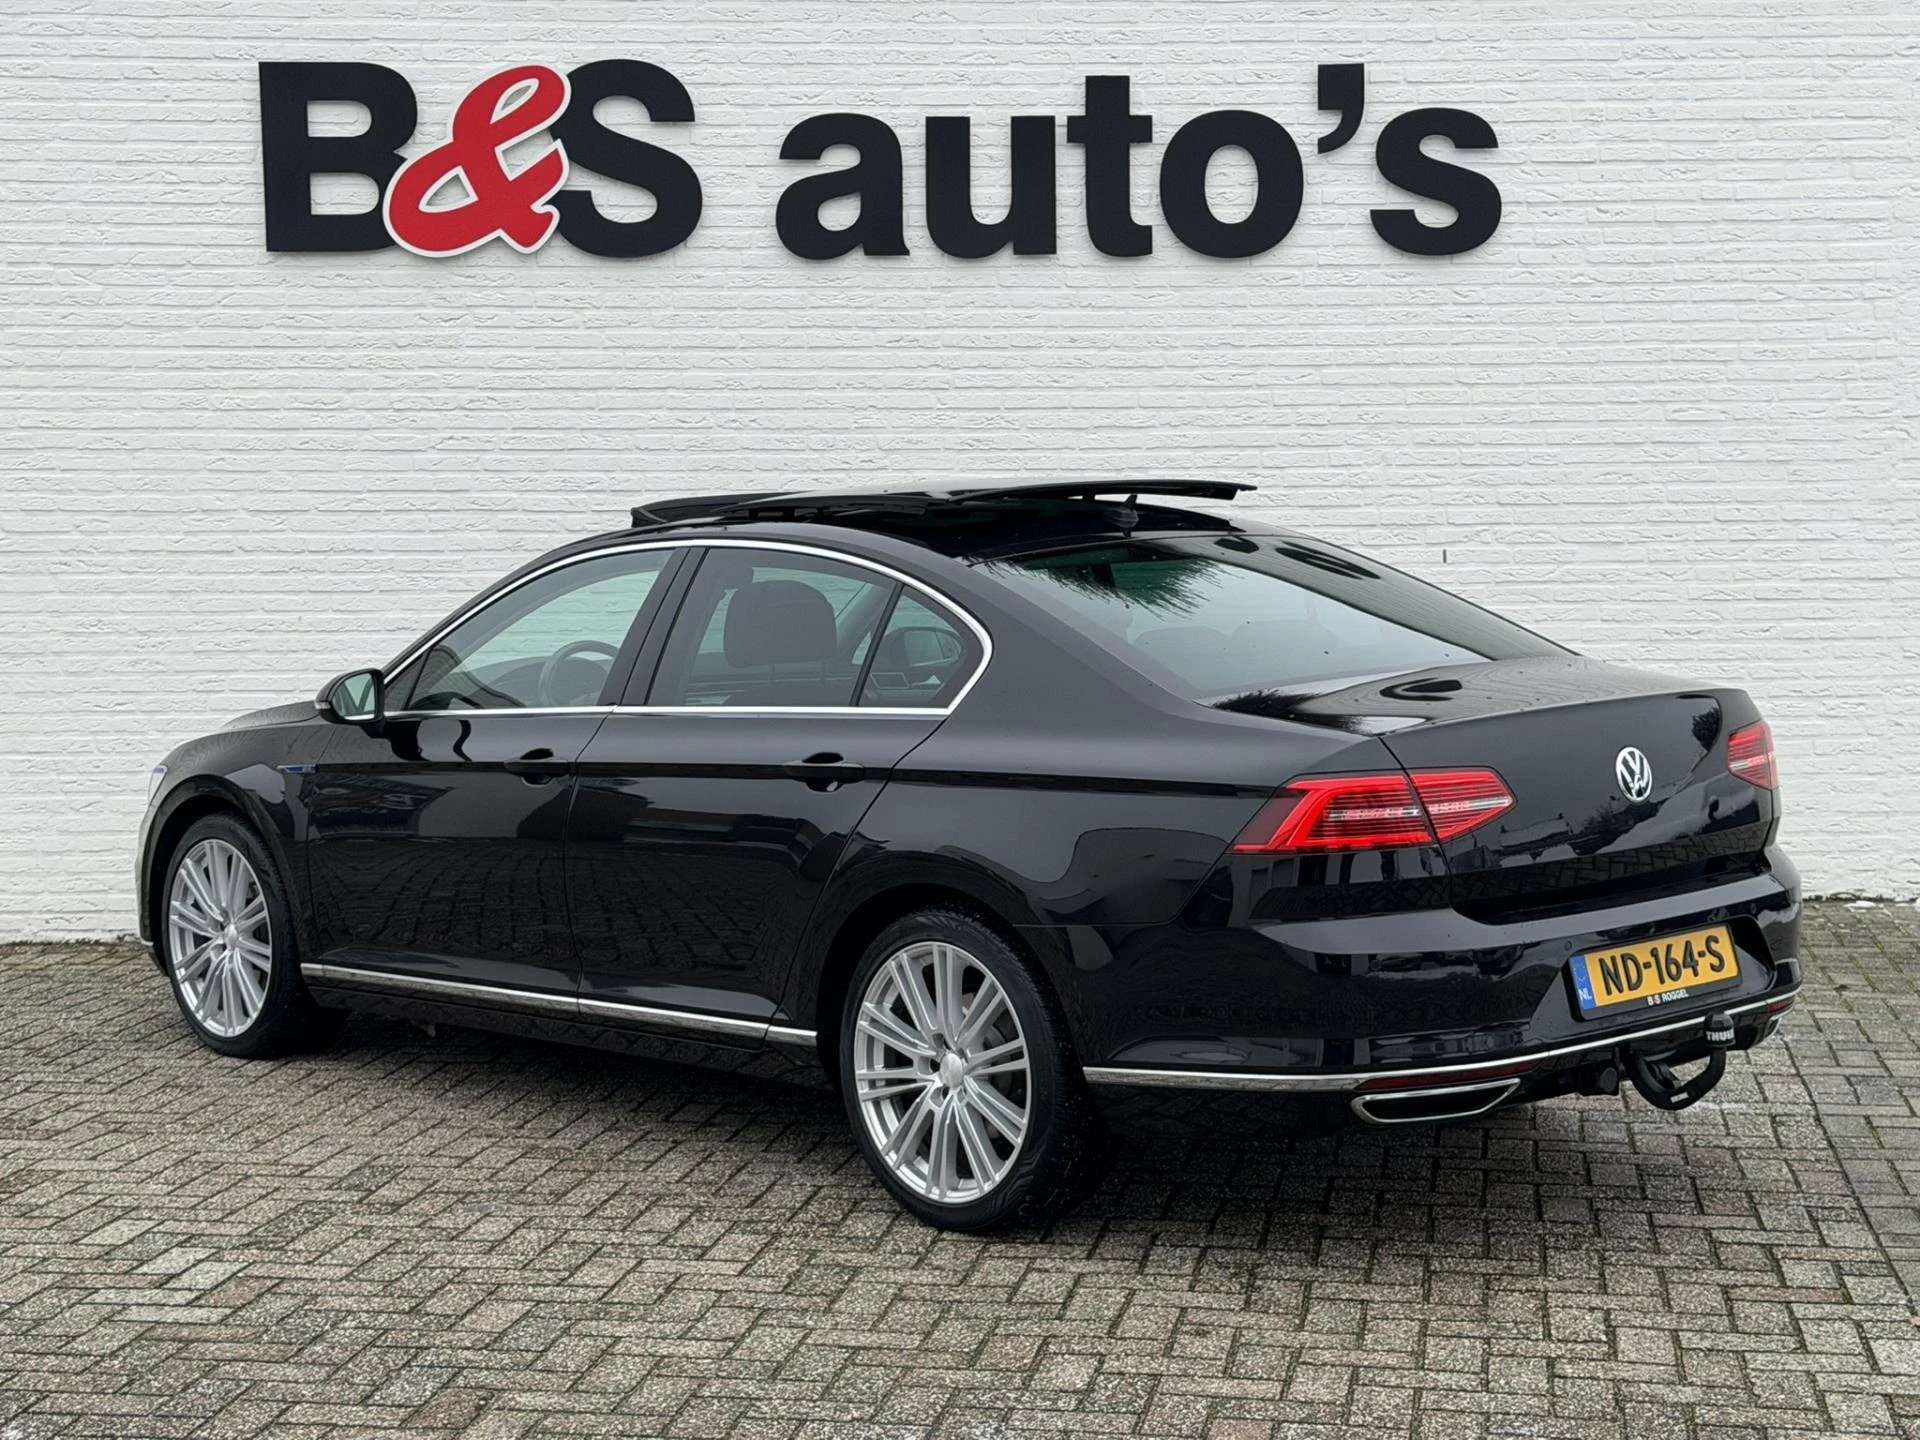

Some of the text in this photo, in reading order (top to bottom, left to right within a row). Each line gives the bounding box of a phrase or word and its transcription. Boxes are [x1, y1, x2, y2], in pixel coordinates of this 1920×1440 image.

[259, 60, 1502, 260] B&S auto's
[1578, 988, 1592, 1000] NL
[1599, 935, 1726, 996] ND-164-S
